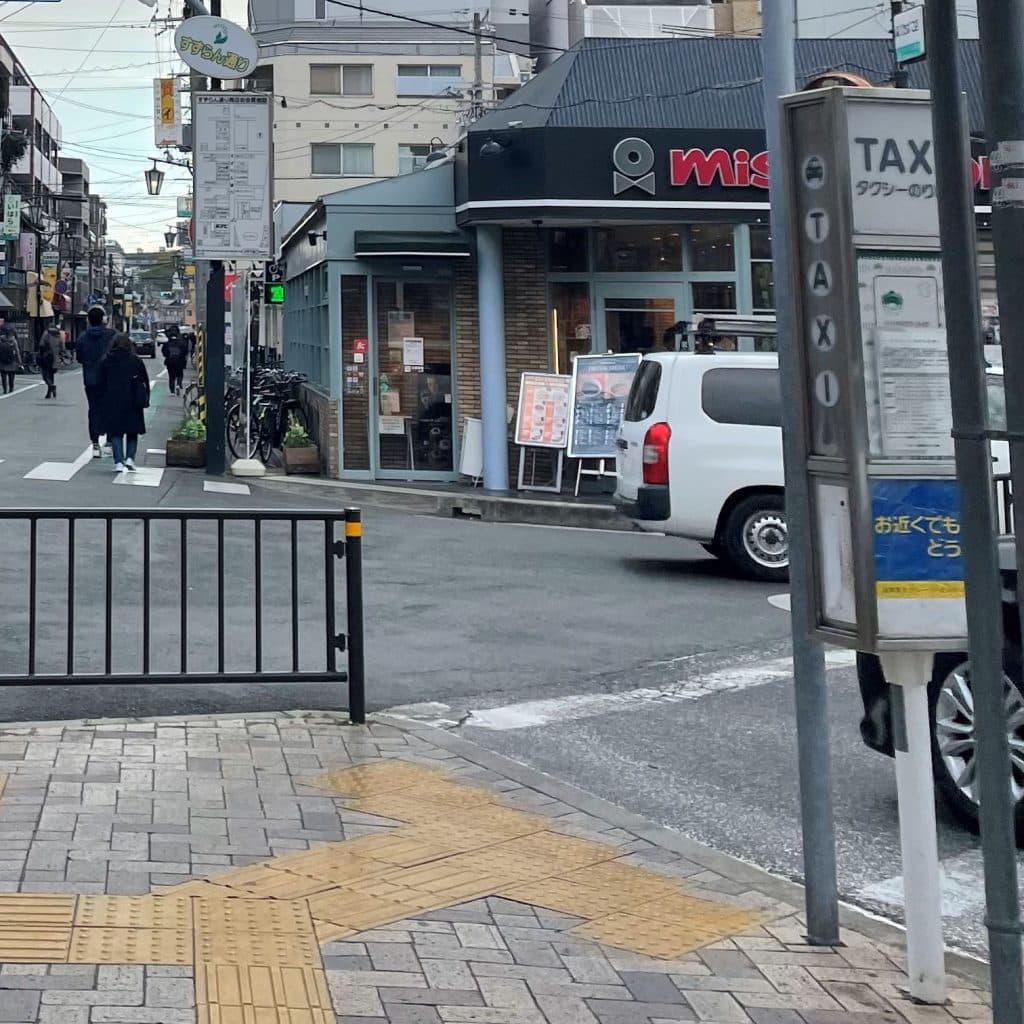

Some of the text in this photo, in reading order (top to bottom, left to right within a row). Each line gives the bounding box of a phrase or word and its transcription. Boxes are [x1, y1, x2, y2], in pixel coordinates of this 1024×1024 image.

[179, 36, 249, 73] すずらん通り
[874, 515, 961, 535] お近くでも
